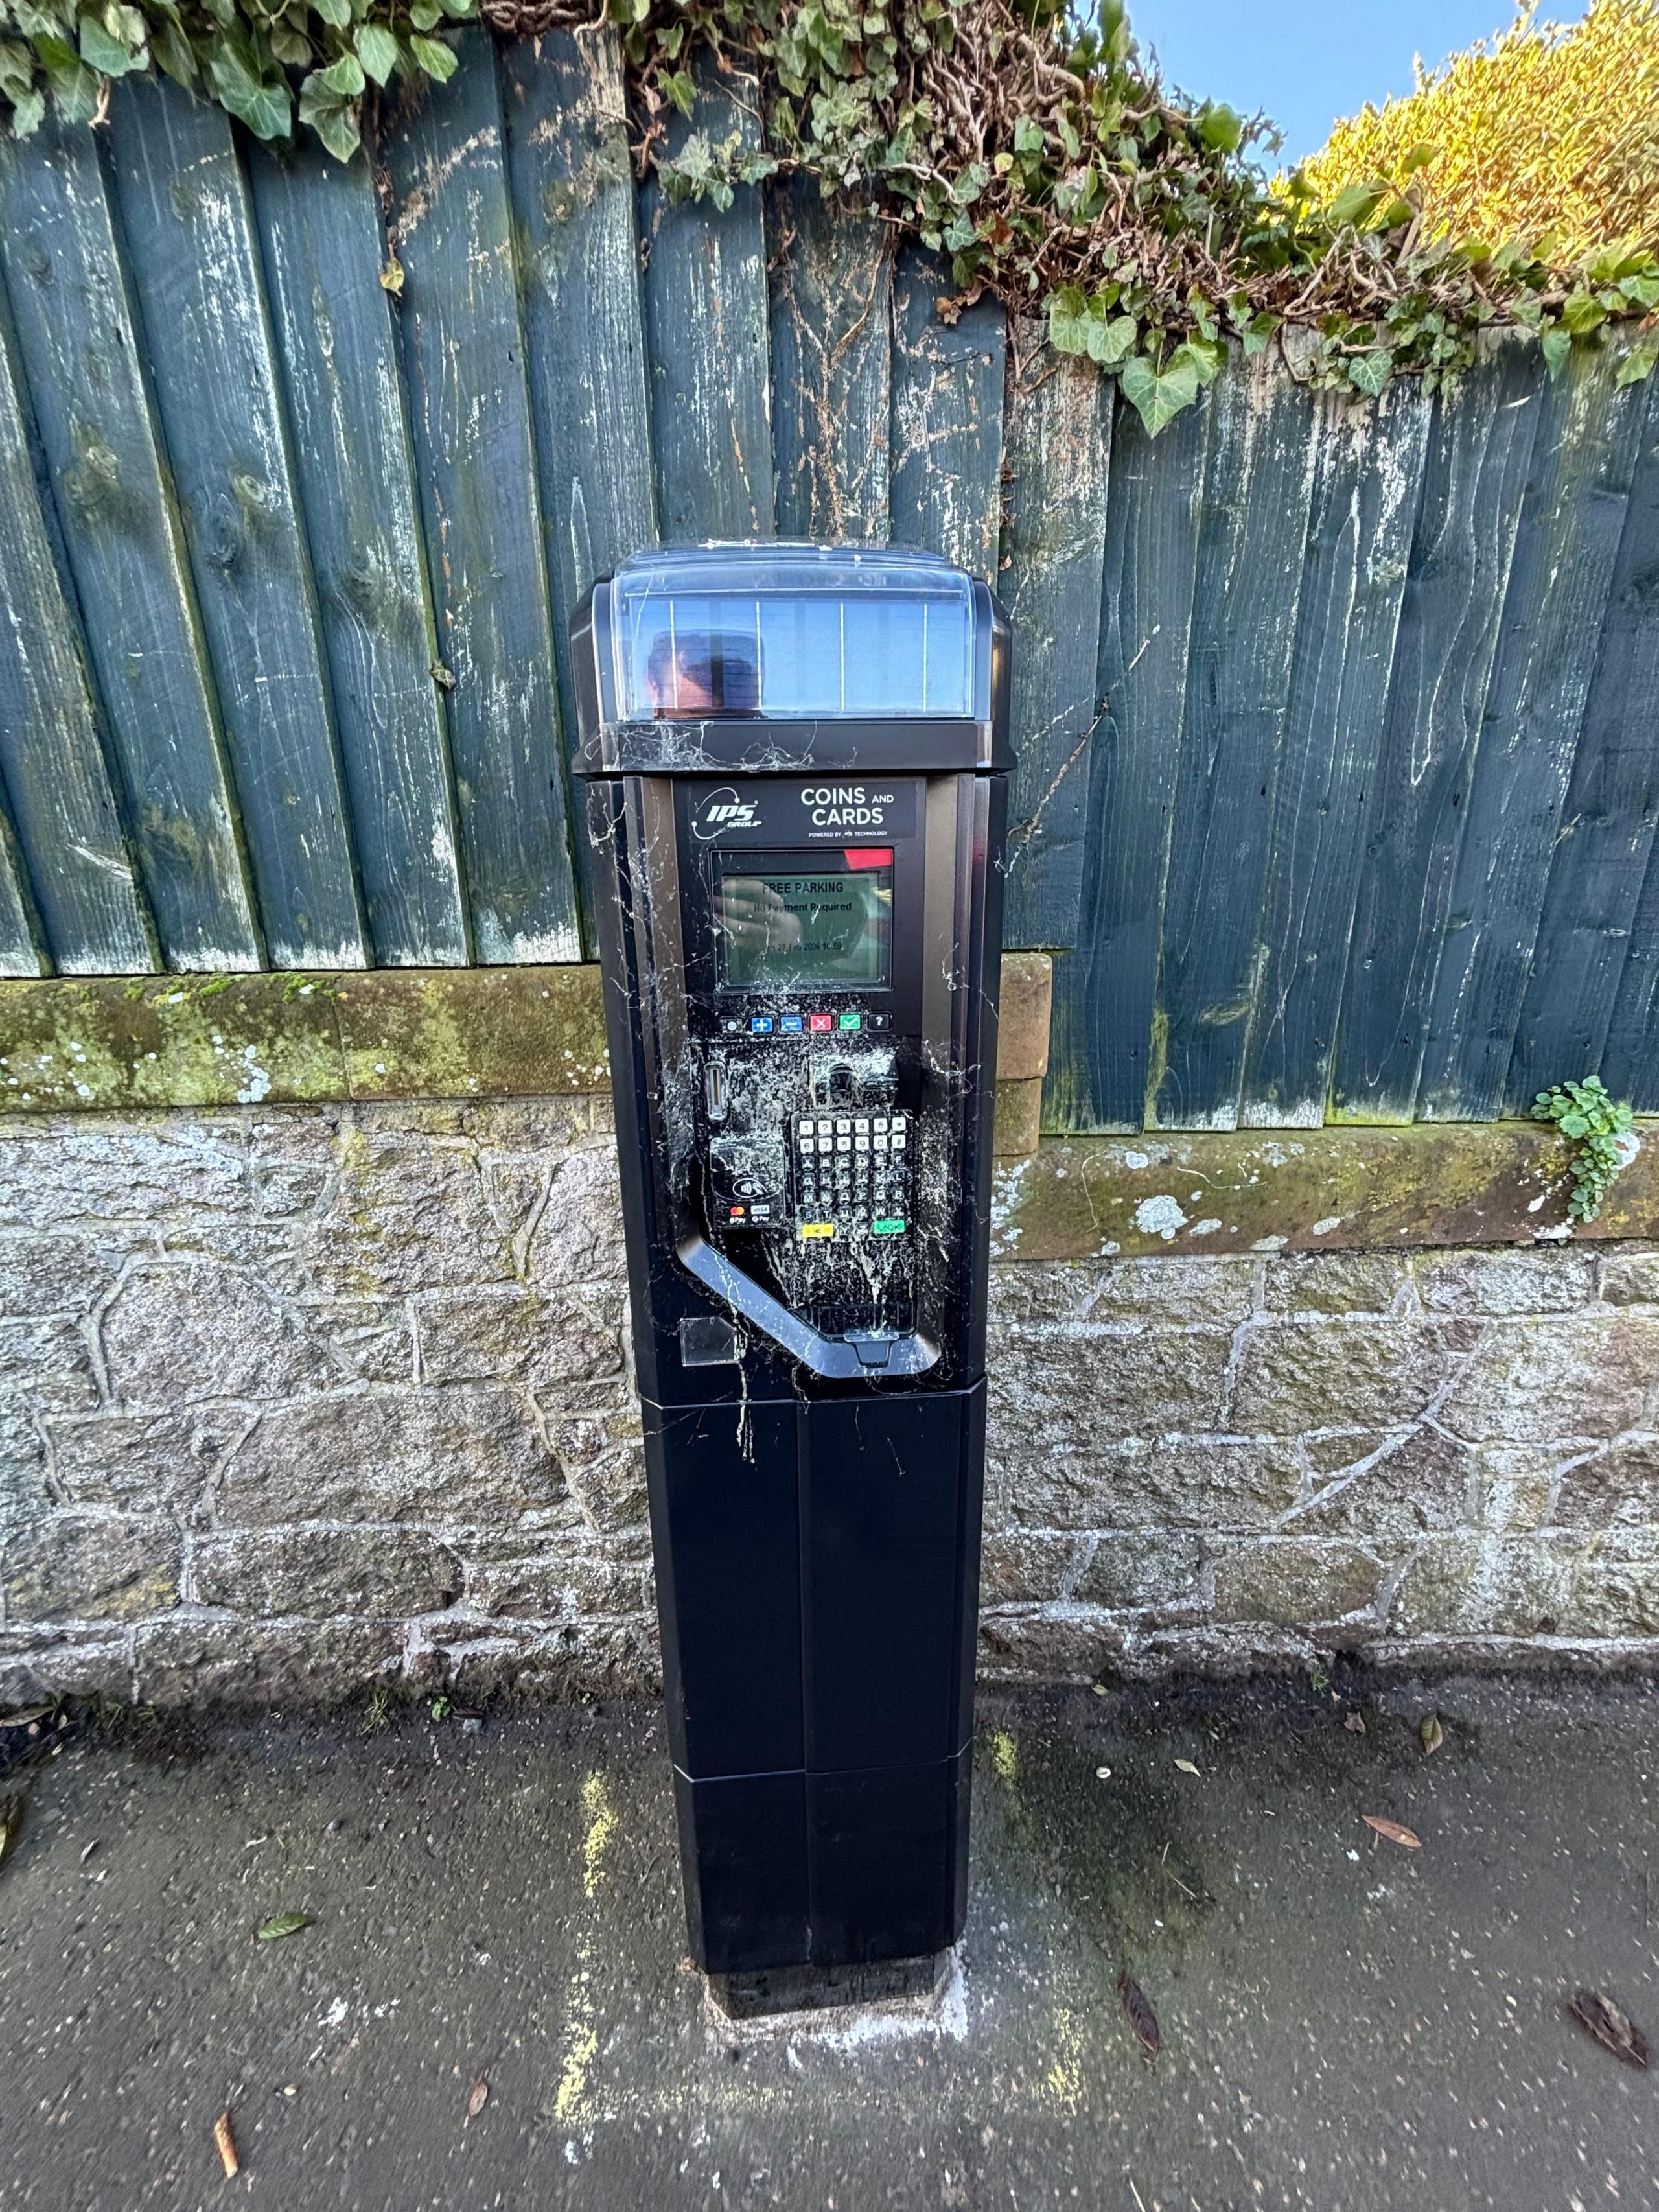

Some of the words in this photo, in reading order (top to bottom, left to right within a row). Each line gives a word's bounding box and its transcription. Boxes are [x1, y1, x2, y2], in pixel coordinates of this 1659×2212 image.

[800, 787, 866, 806] COINS
[872, 795, 894, 804] AND
[706, 804, 757, 822] IPS
[811, 808, 884, 826] CARDS
[763, 883, 791, 894] FREE
[795, 881, 844, 893] PARKING
[754, 903, 765, 913] No
[767, 903, 808, 913] Payment
[811, 902, 852, 913] Required
[778, 944, 786, 952] 27
